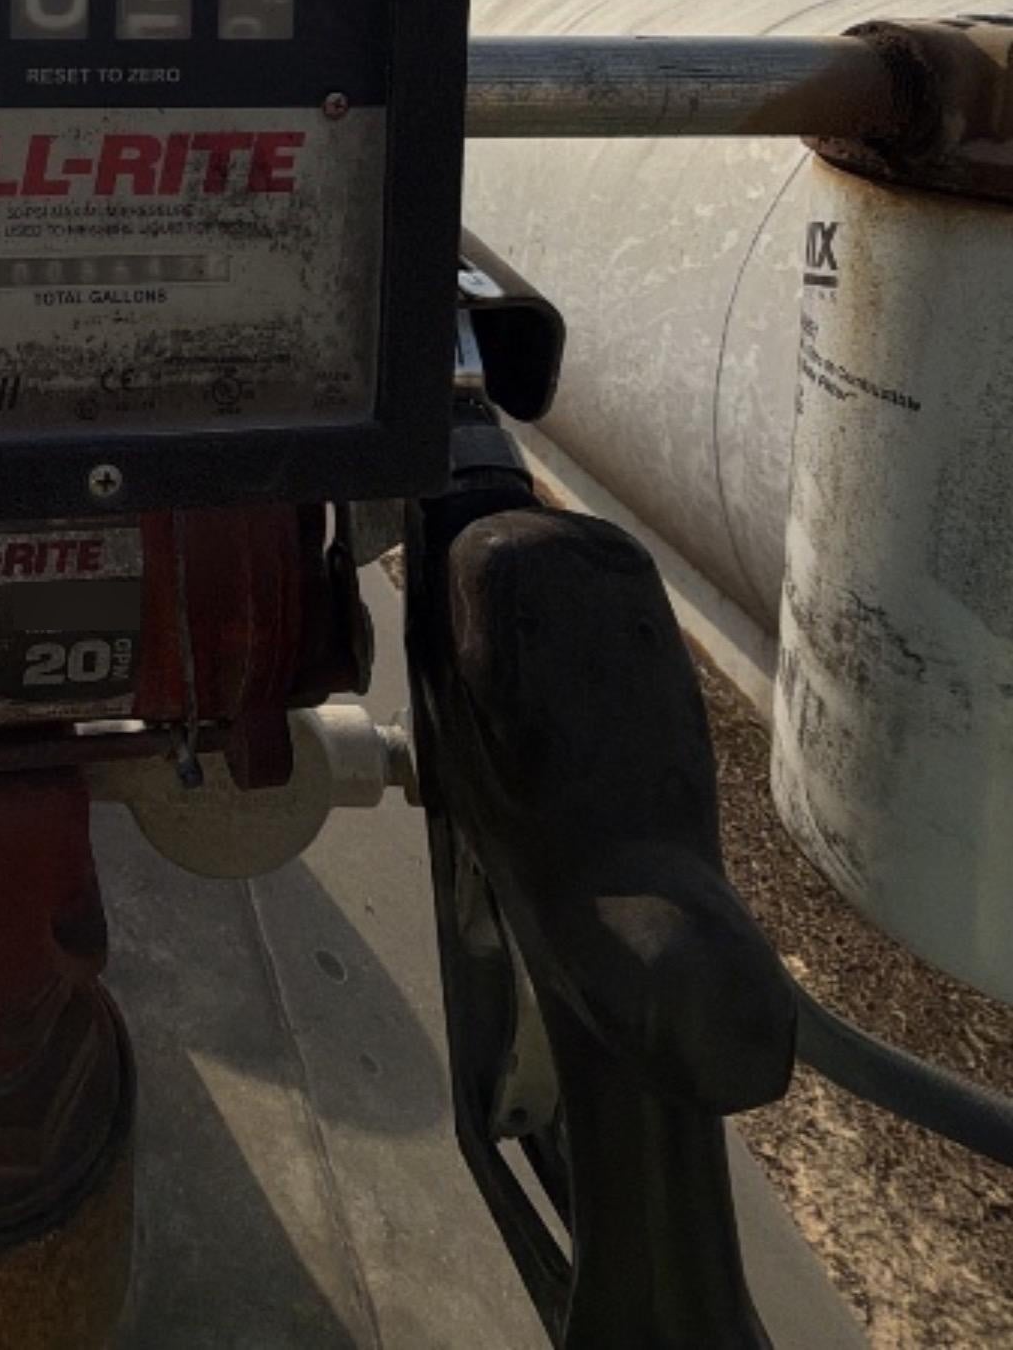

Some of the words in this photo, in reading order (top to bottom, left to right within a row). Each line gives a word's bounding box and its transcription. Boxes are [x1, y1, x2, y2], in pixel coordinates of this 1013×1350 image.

[25, 67, 92, 84] RESET
[96, 67, 123, 83] TO
[126, 66, 181, 83] ZERO
[34, 289, 83, 306] TOTAL
[90, 289, 168, 305] GALLONS
[22, 638, 111, 685] 20
